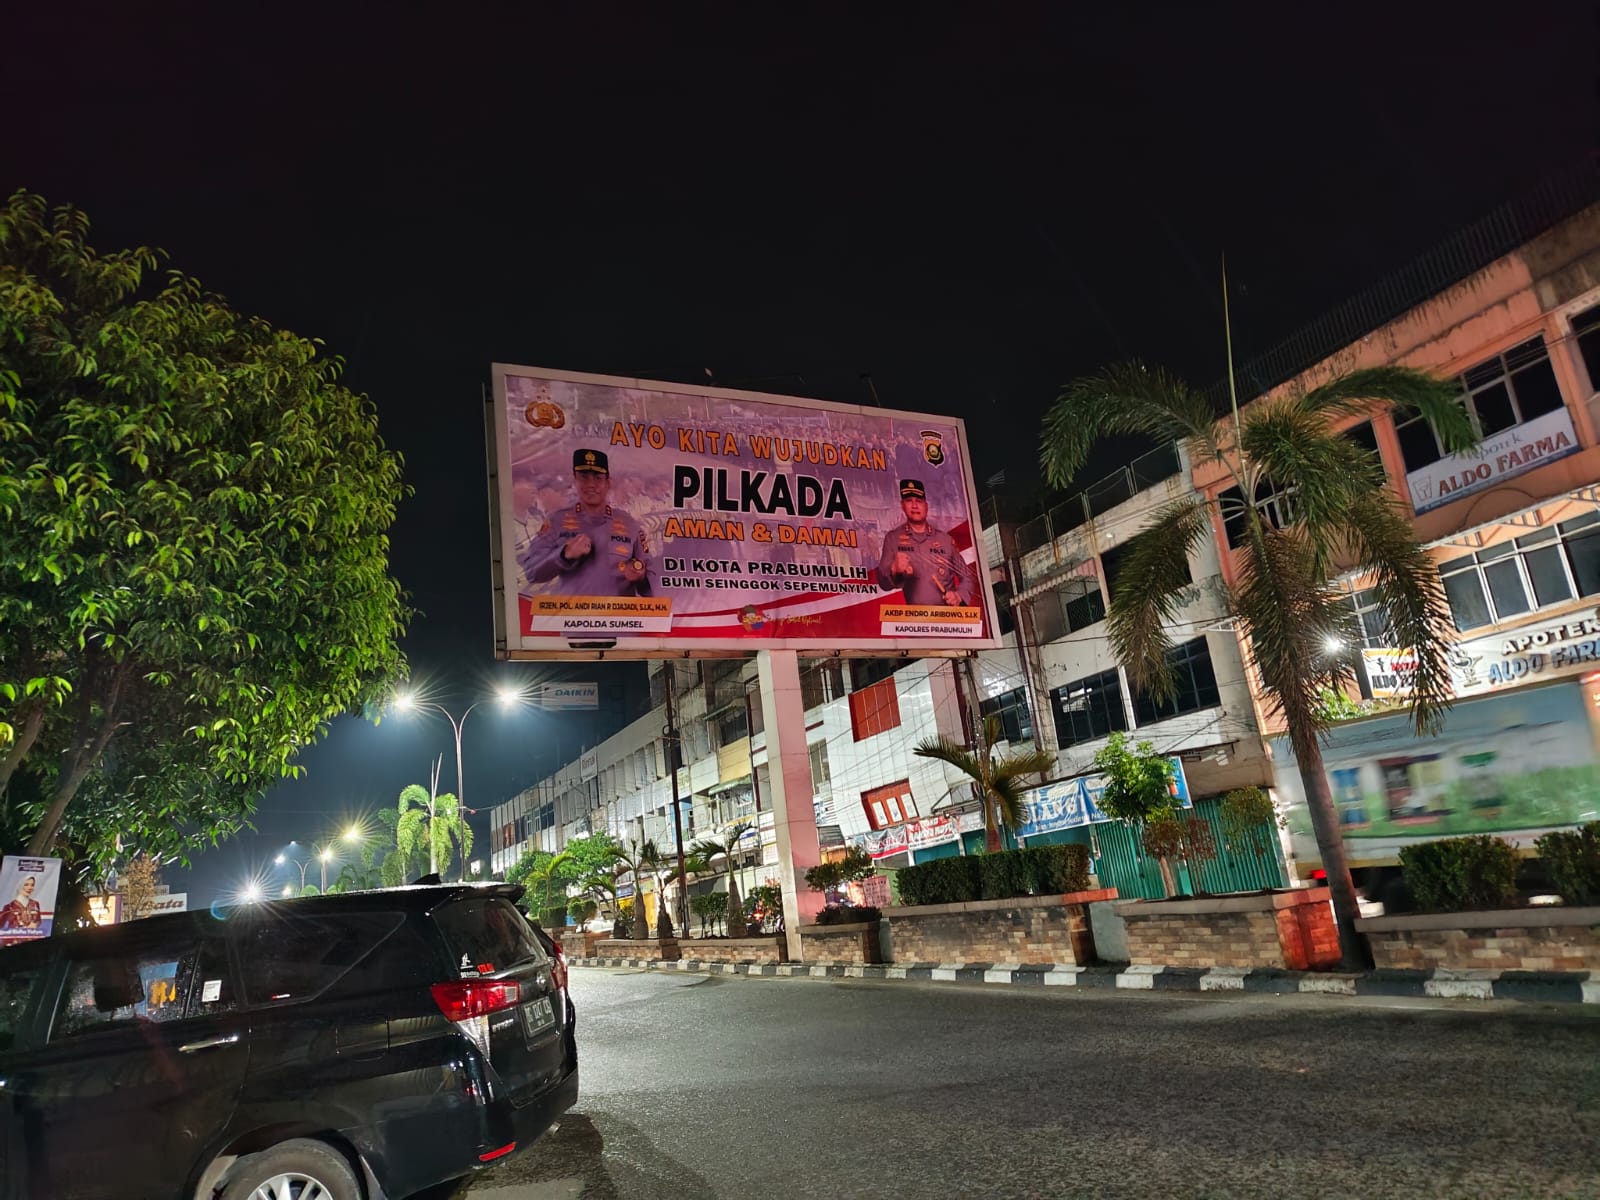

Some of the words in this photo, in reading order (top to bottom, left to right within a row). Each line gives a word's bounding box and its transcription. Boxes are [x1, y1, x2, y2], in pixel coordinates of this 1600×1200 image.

[610, 421, 666, 450] AYO
[678, 427, 740, 457] KITA
[748, 434, 887, 471] WUJUDKAN
[1438, 462, 1492, 497] ALDO
[1496, 431, 1571, 473] FARMA
[673, 464, 853, 521] PILKADA
[664, 517, 745, 542] AMAN
[751, 523, 773, 543] &
[777, 523, 858, 549] DAMAI
[664, 557, 686, 572] DI
[692, 560, 742, 574] KOTA
[748, 561, 868, 580] PRABUMULIH
[661, 576, 701, 588] BUMI
[704, 578, 781, 591] SEINGGOK
[783, 581, 879, 595] SEPEMUNYIAN
[574, 602, 590, 610] ANDI
[590, 602, 606, 611] RIAN
[884, 609, 904, 618] AKBP
[904, 610, 929, 618] ENDRO
[563, 620, 608, 629] KAPOLDA
[609, 620, 644, 629] SUMSEL
[895, 625, 930, 633] KAPOLRES
[930, 626, 973, 634] PRABUMULIH
[1488, 653, 1544, 685] ALDO
[554, 688, 595, 697] DAIKIN
